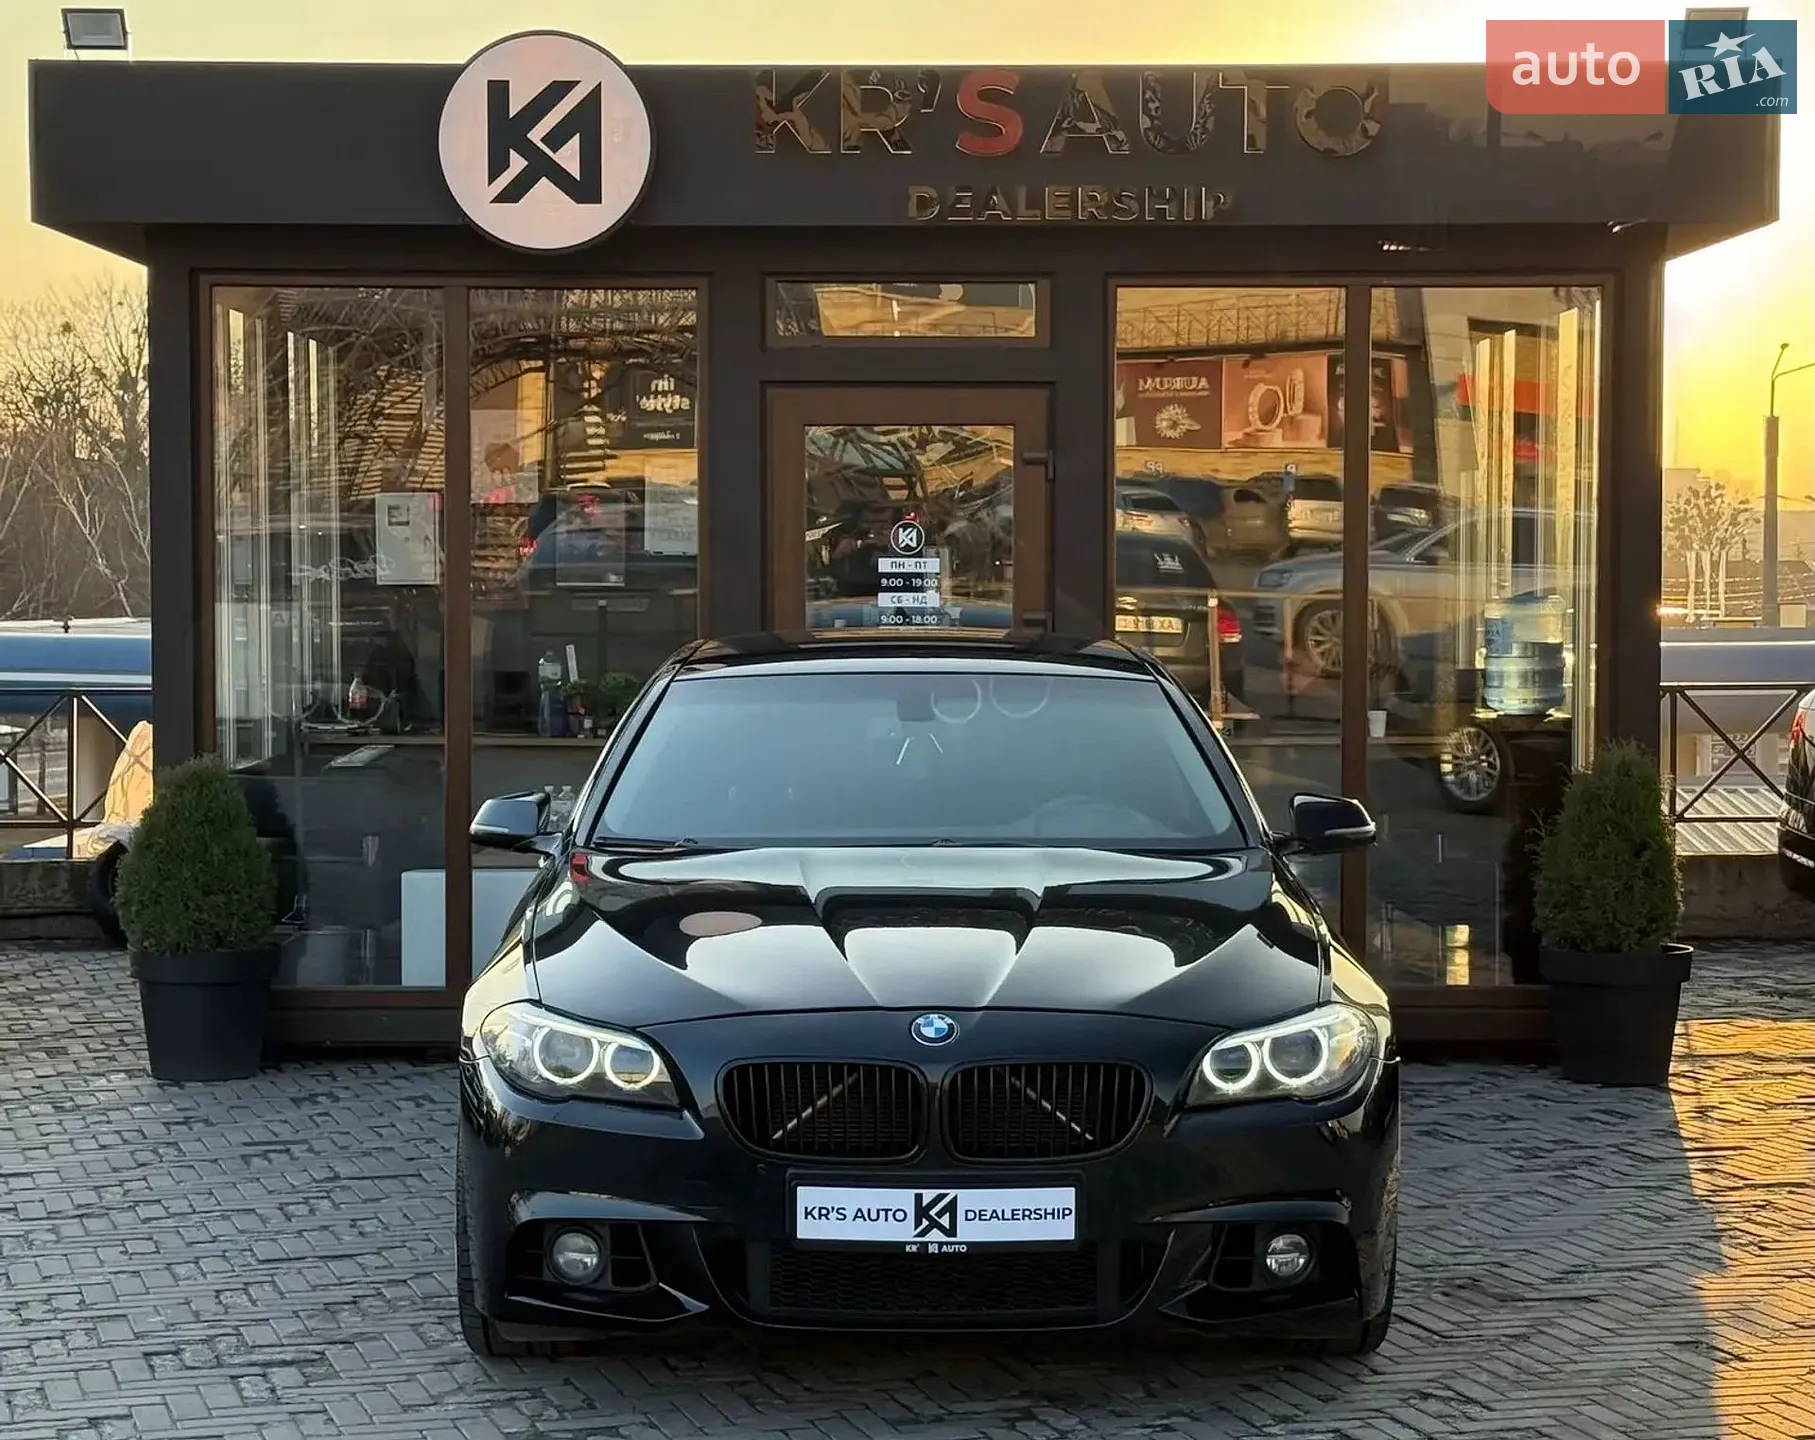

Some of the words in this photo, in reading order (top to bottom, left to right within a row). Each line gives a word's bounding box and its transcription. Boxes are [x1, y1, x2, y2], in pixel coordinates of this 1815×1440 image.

[1040, 67, 1383, 157] AUTO
[907, 184, 1232, 222] DEALERSHIP
[890, 561, 905, 570] ПН
[915, 561, 928, 570] ПТ
[803, 1206, 847, 1222] KR'S
[852, 1208, 908, 1223] AUTO
[964, 1206, 1073, 1222] DEALERSHIP
[941, 1244, 968, 1253] AUTO
